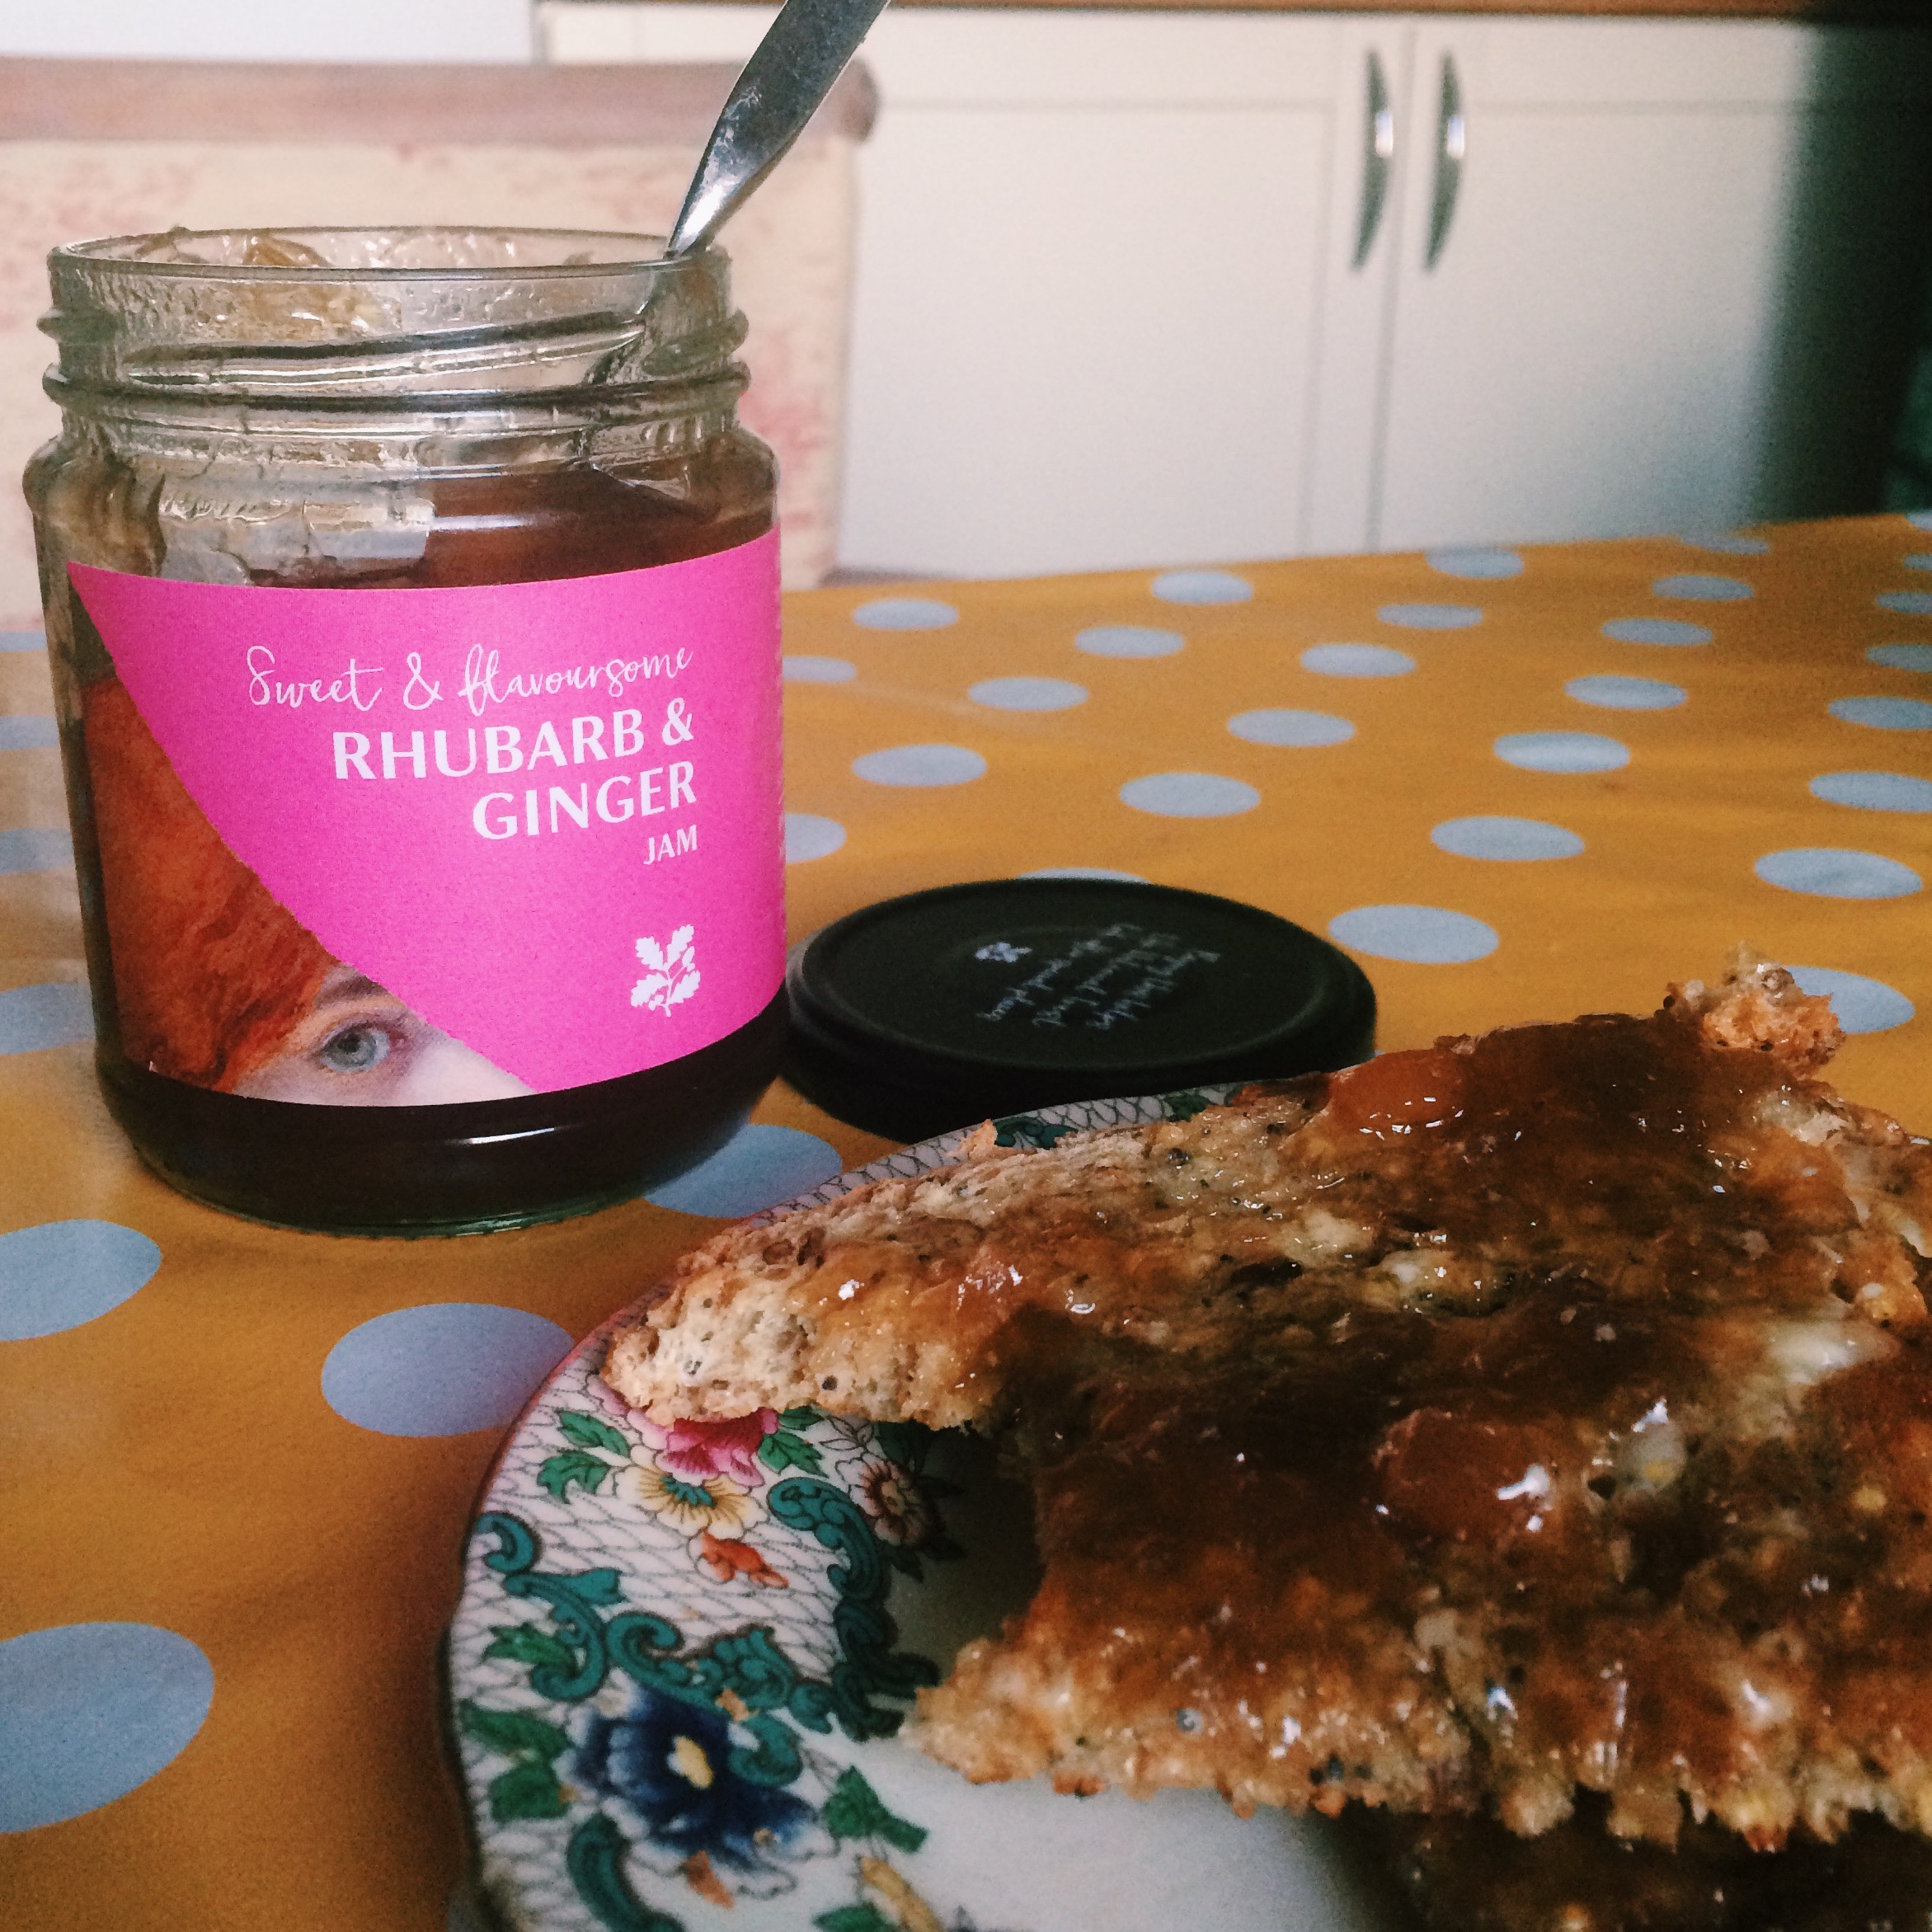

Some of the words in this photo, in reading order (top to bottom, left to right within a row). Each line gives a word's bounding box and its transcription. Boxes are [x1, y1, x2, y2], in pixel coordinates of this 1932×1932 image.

[246, 645, 384, 712] Sweet
[402, 651, 443, 711] &
[457, 643, 694, 717] flavoursome
[332, 708, 645, 780] RHUBARB
[661, 697, 694, 746] &
[472, 760, 697, 841] GINGER
[642, 825, 698, 866] JAM
